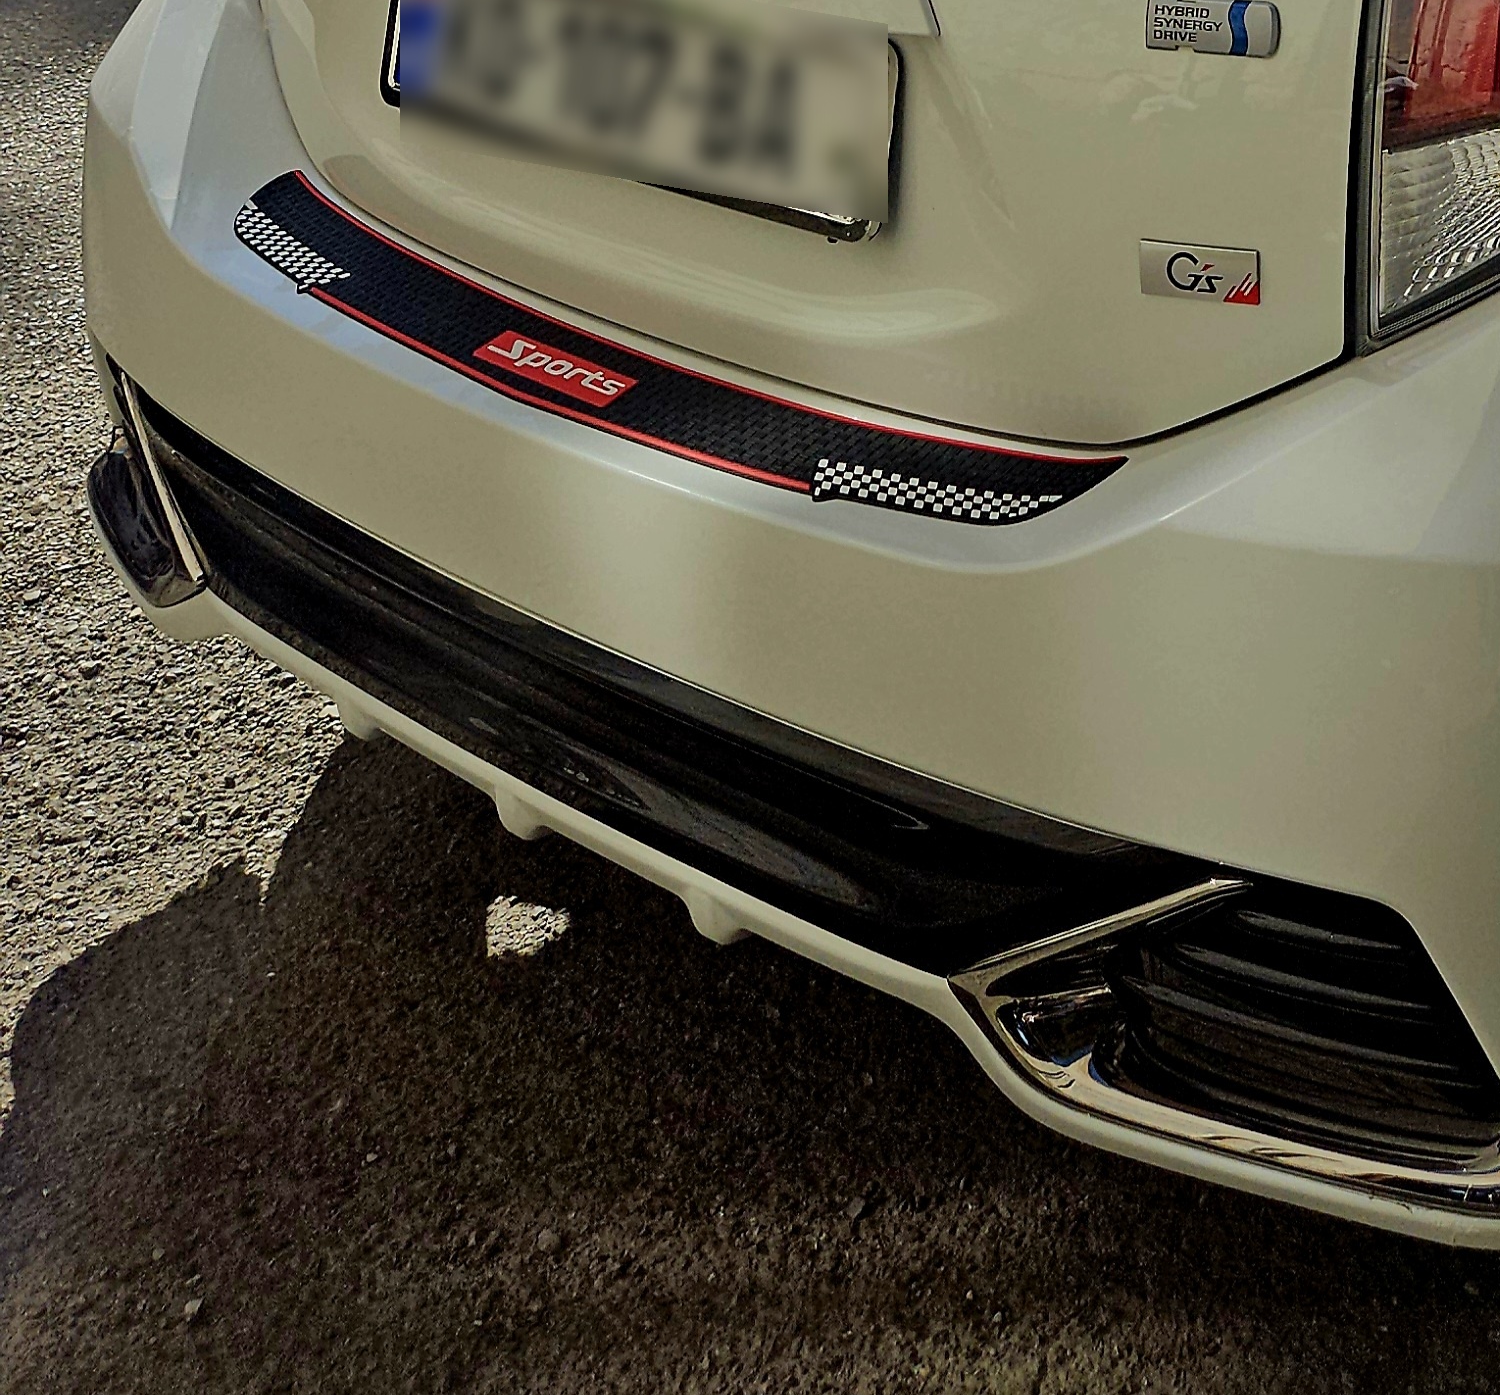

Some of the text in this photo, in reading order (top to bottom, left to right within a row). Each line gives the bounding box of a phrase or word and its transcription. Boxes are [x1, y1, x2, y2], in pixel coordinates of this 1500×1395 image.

[1154, 4, 1210, 19] HYBRID
[1153, 17, 1223, 32] SYNERGY
[1153, 29, 1197, 43] DRIVE
[487, 339, 626, 396] Sports
